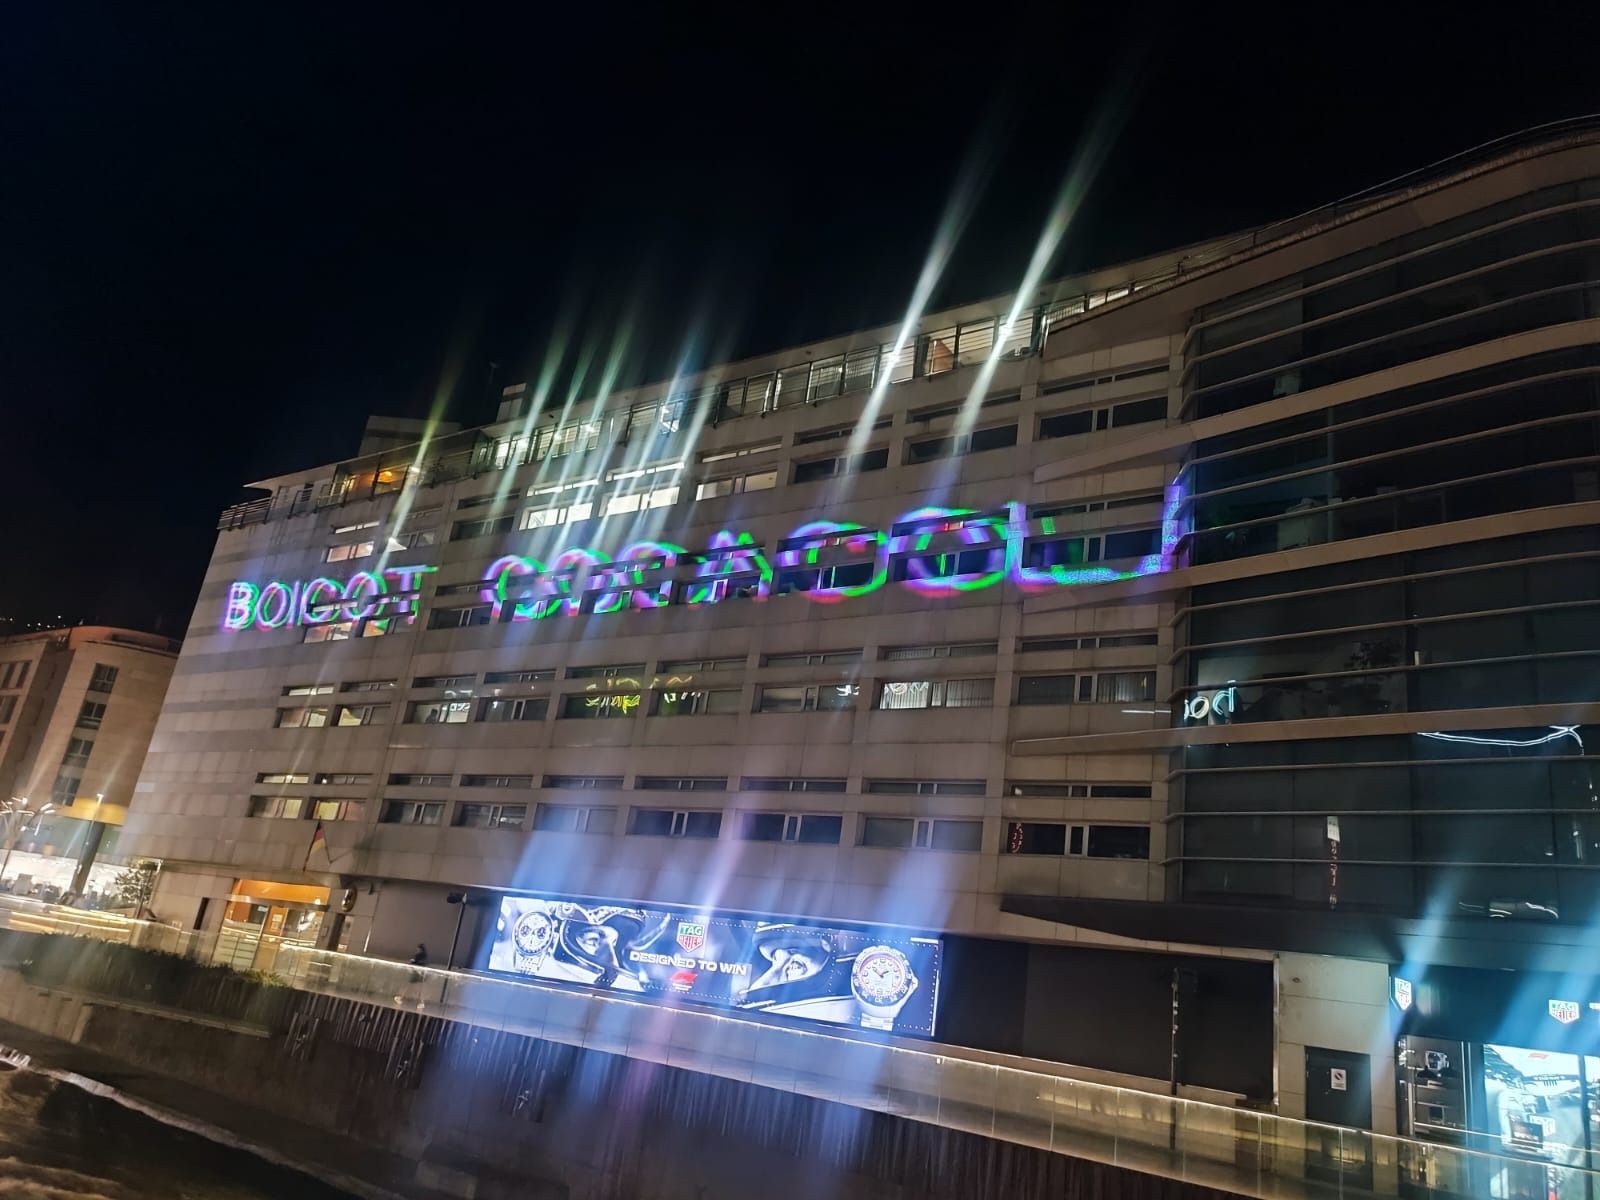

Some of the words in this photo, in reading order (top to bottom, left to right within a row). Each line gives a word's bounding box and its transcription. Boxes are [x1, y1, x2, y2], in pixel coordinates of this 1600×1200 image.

[222, 565, 438, 633] BOICOT
[682, 925, 703, 936] TAG
[679, 935, 703, 950] HEUER
[629, 951, 696, 969] DESIGNED
[699, 961, 718, 972] TO
[720, 962, 748, 976] WIN
